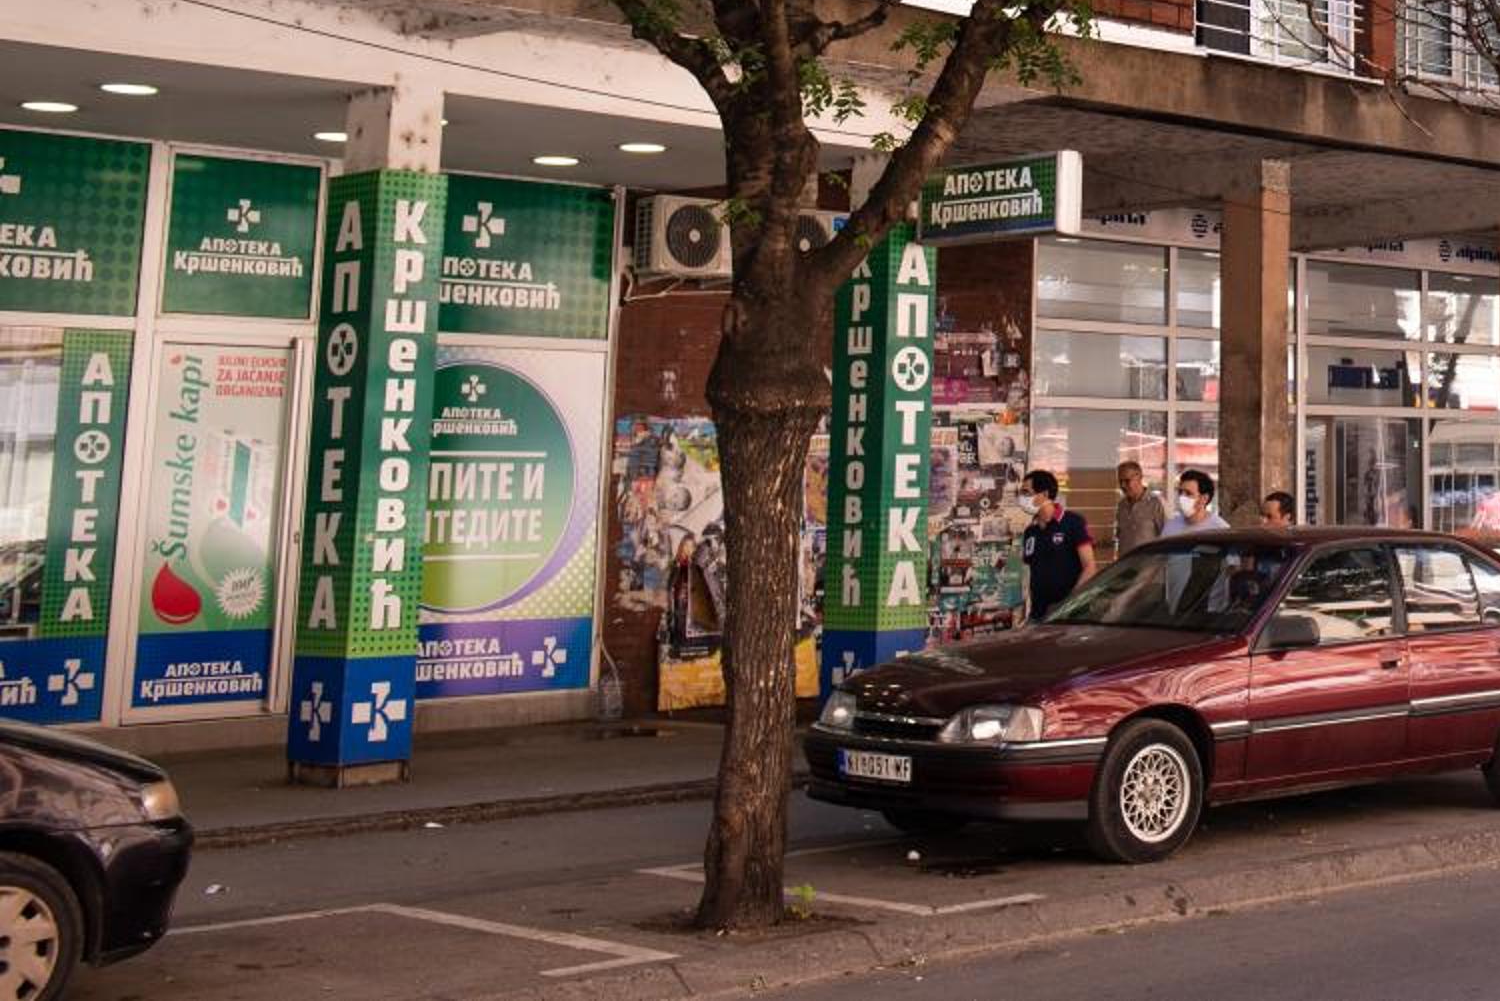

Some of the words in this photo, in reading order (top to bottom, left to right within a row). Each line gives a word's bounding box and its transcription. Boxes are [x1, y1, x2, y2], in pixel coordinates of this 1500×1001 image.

[943, 166, 1033, 196] АПОТЕКА
[931, 189, 1043, 228] Кршенковић
[201, 237, 281, 256] АПОТЕКА
[173, 251, 303, 277] Кршенковић
[169, 355, 210, 424] kapi
[371, 200, 427, 629] Кршенковић
[441, 407, 501, 419] АПОТЕКА
[887, 242, 931, 607] АПОТЕКА
[58, 352, 114, 621] АПОТЕКА
[151, 433, 197, 560] Šumske
[165, 660, 243, 677] АПОТЕКА
[140, 672, 263, 701] Кршенковић
